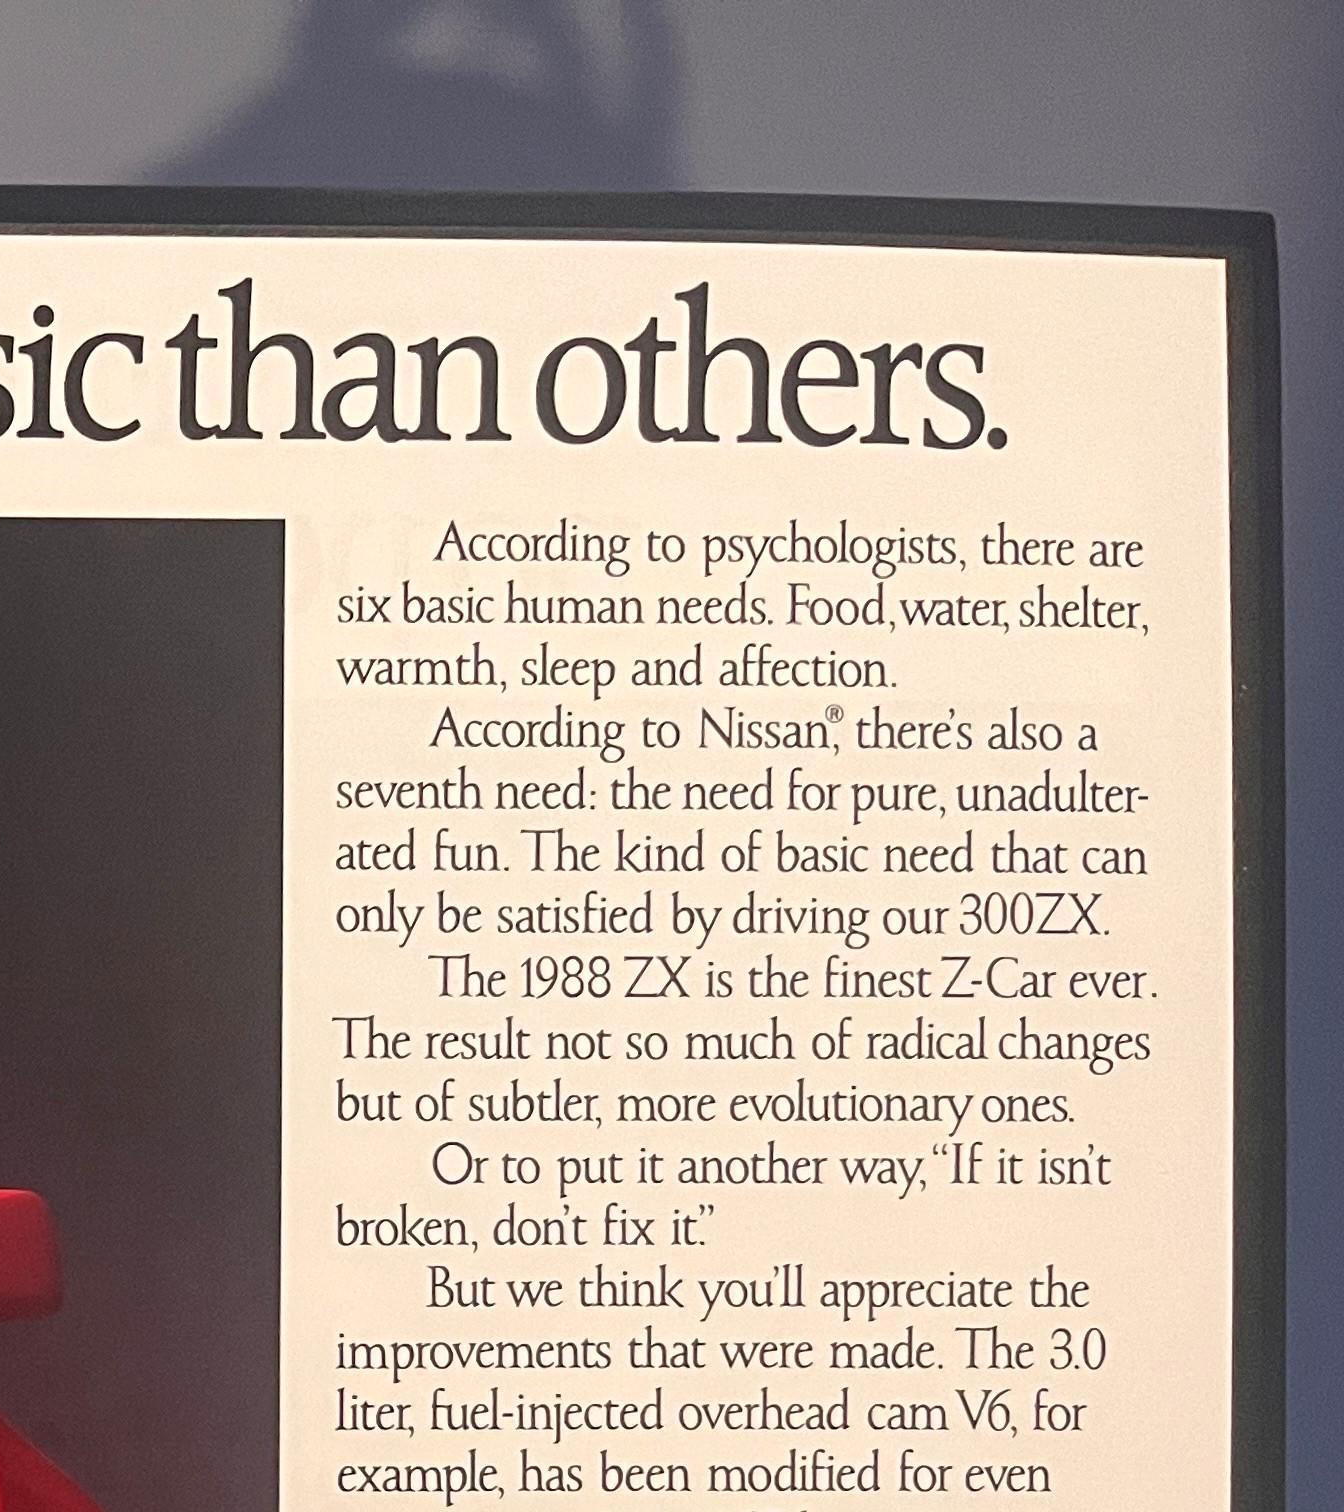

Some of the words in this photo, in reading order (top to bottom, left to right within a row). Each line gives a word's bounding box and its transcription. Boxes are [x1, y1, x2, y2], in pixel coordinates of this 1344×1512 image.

[166, 278, 511, 443] than
[536, 282, 1007, 449] others.
[432, 517, 630, 577] According
[647, 531, 685, 563] to
[702, 519, 966, 579] psychologists,
[981, 522, 1075, 566] there
[1089, 541, 1143, 567] are
[336, 642, 506, 693] warmth,
[522, 641, 615, 701] sleep
[632, 642, 702, 686] and
[719, 643, 896, 687] affection.
[337, 765, 484, 809] seventh
[495, 766, 596, 810] need:
[611, 766, 671, 810] the
[682, 766, 774, 810] need
[787, 767, 842, 811] for
[851, 784, 945, 825] pure,
[956, 768, 1148, 813] unadulter-
[336, 827, 416, 871] ated
[434, 828, 509, 871] fun.
[520, 828, 600, 871] The
[614, 828, 705, 873] kind
[721, 829, 762, 872] of
[776, 830, 868, 872] basic
[883, 829, 974, 873] need
[991, 829, 1068, 874] that
[1082, 847, 1148, 875] can
[336, 888, 425, 948] only
[437, 890, 482, 933] be
[497, 890, 653, 933] satisfied
[672, 891, 722, 950] by
[733, 890, 870, 949] driving
[883, 908, 950, 935] our
[960, 892, 1109, 935] 300ZX.
[428, 954, 506, 997] The
[521, 956, 611, 999] 1988
[624, 956, 692, 998] ZX
[705, 962, 733, 998] is
[748, 954, 809, 998] the
[824, 954, 932, 998] finest
[941, 956, 1056, 998] Z-Car
[1070, 972, 1157, 999] ever.
[332, 1015, 411, 1059] The
[424, 1016, 531, 1060] result
[545, 1029, 612, 1060] not
[626, 1033, 668, 1060] so
[684, 1016, 796, 1060] much
[812, 1016, 852, 1060] of
[865, 1016, 989, 1059] radical
[999, 1016, 1150, 1075] changes
[336, 1078, 402, 1121] but
[415, 1078, 455, 1121] of
[469, 1077, 601, 1129] subtler,
[616, 1095, 716, 1122] more
[730, 1078, 974, 1137] evolutionary
[982, 1096, 1074, 1123] ones.
[336, 1333, 611, 1384] improvements
[628, 1325, 706, 1368] that
[720, 1342, 813, 1368] were
[829, 1325, 943, 1369] made.
[955, 1325, 1034, 1369] The
[1050, 1328, 1106, 1370] 3.0
[335, 1387, 414, 1438] liter,
[430, 1387, 664, 1444] fuel-injected
[679, 1387, 850, 1430] overhead
[868, 1404, 950, 1430] cam
[955, 1389, 1017, 1438] V6,
[1033, 1388, 1087, 1431] for
[338, 1448, 504, 1507] example,
[518, 1448, 583, 1492] has
[600, 1449, 692, 1492] been
[707, 1448, 880, 1492] modified
[898, 1449, 953, 1492] for
[965, 1465, 1051, 1492] even
